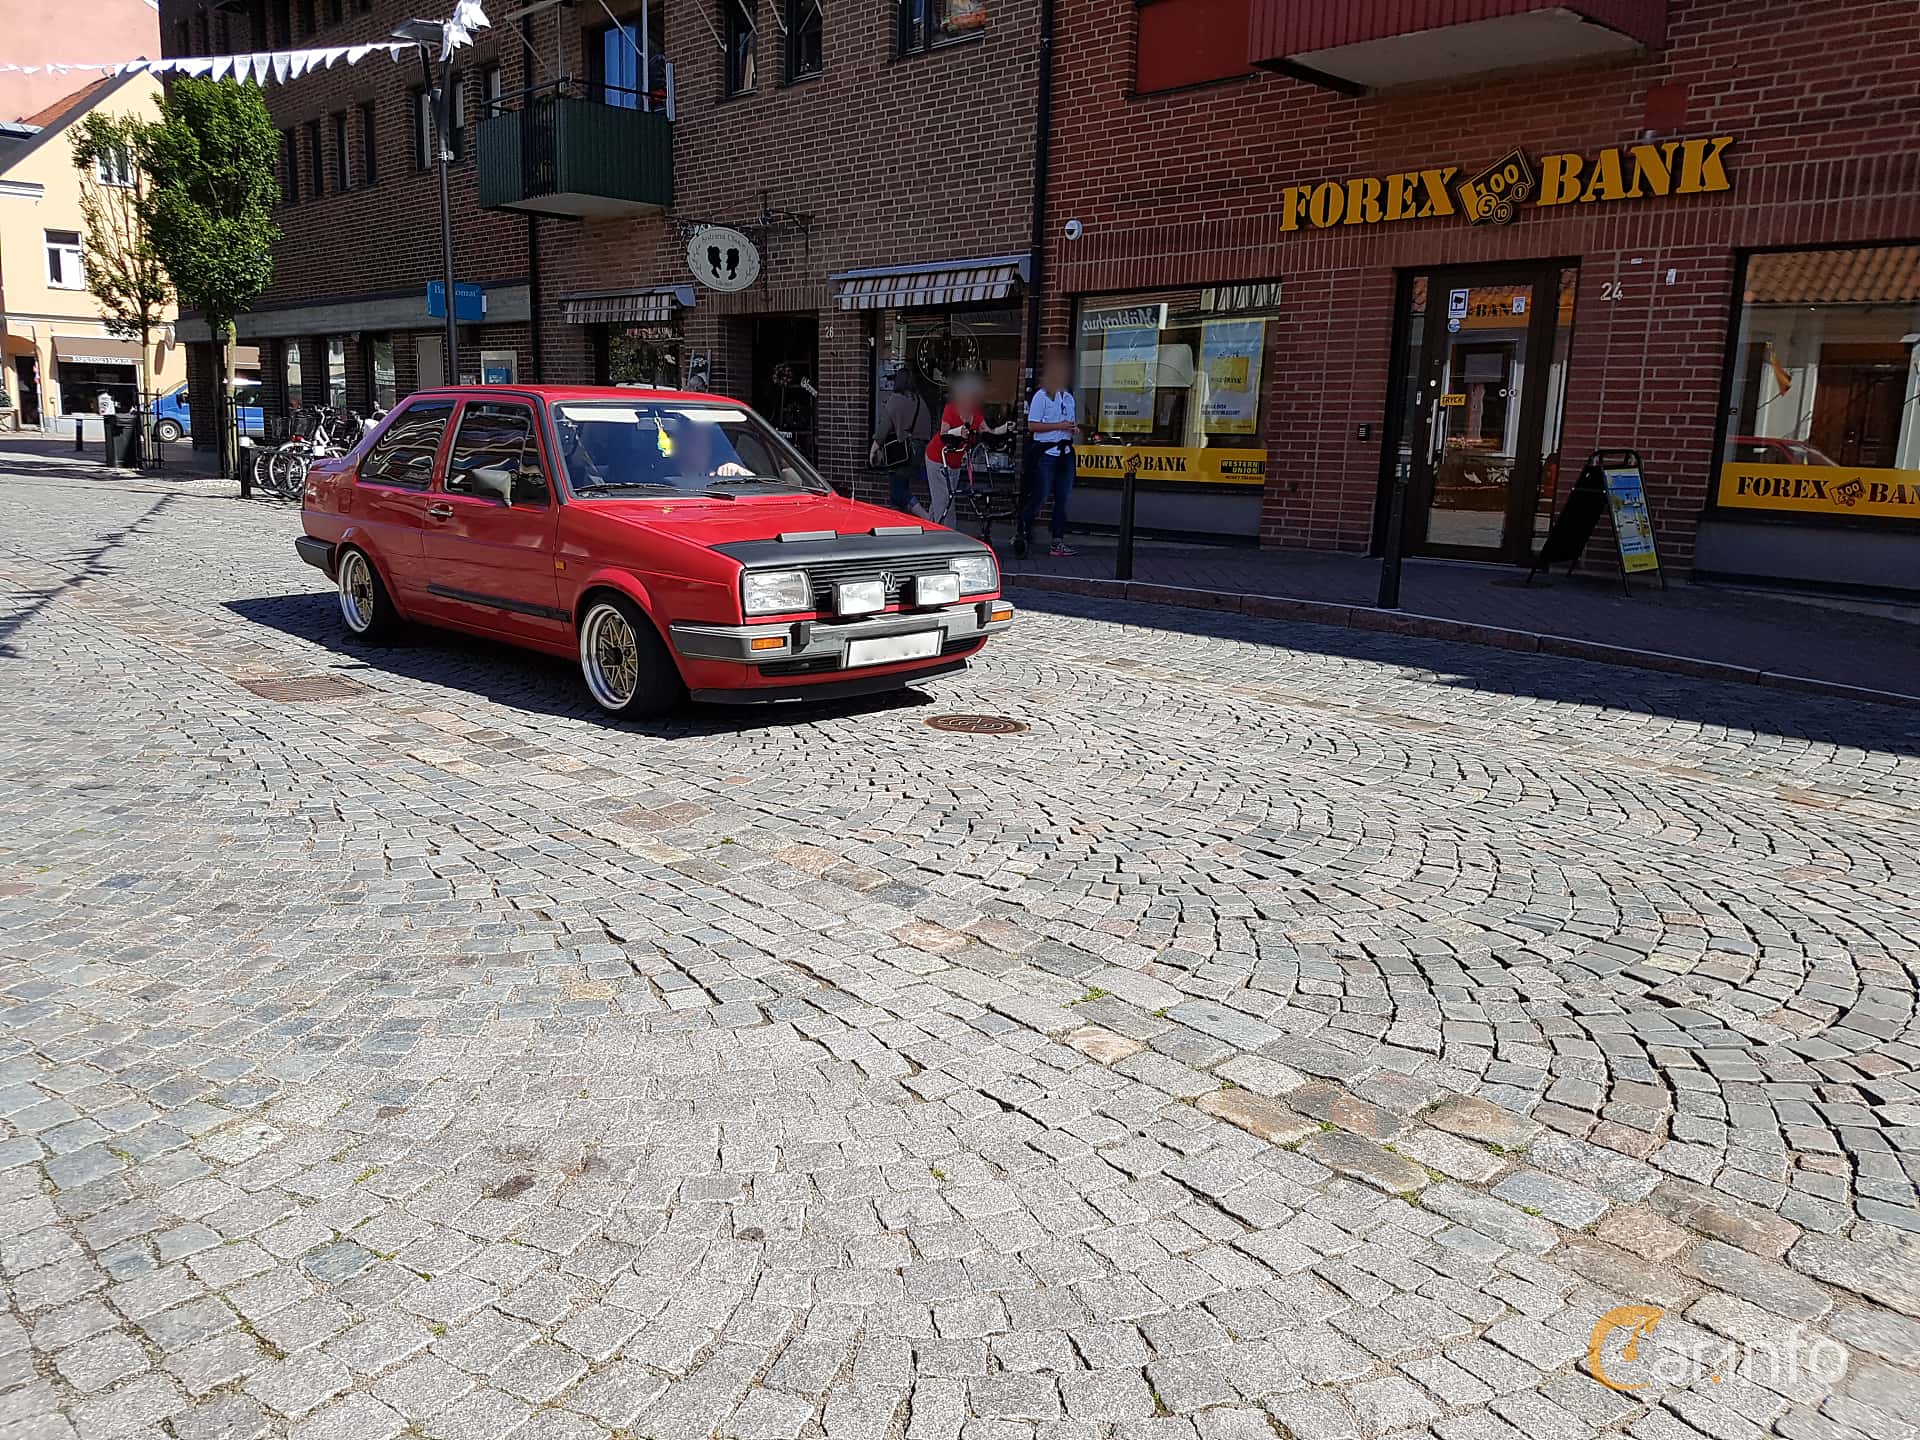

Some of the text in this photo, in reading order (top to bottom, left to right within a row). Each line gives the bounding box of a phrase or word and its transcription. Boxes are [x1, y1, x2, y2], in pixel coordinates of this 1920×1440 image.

[1280, 137, 1733, 231] FOREX BANK
[1600, 281, 1623, 301] 24
[1077, 454, 1123, 470] FOREX
[1143, 456, 1187, 473] BANK
[1222, 460, 1257, 468] WESTERN
[1232, 466, 1257, 474] UNION
[1736, 476, 1829, 499] FOREX
